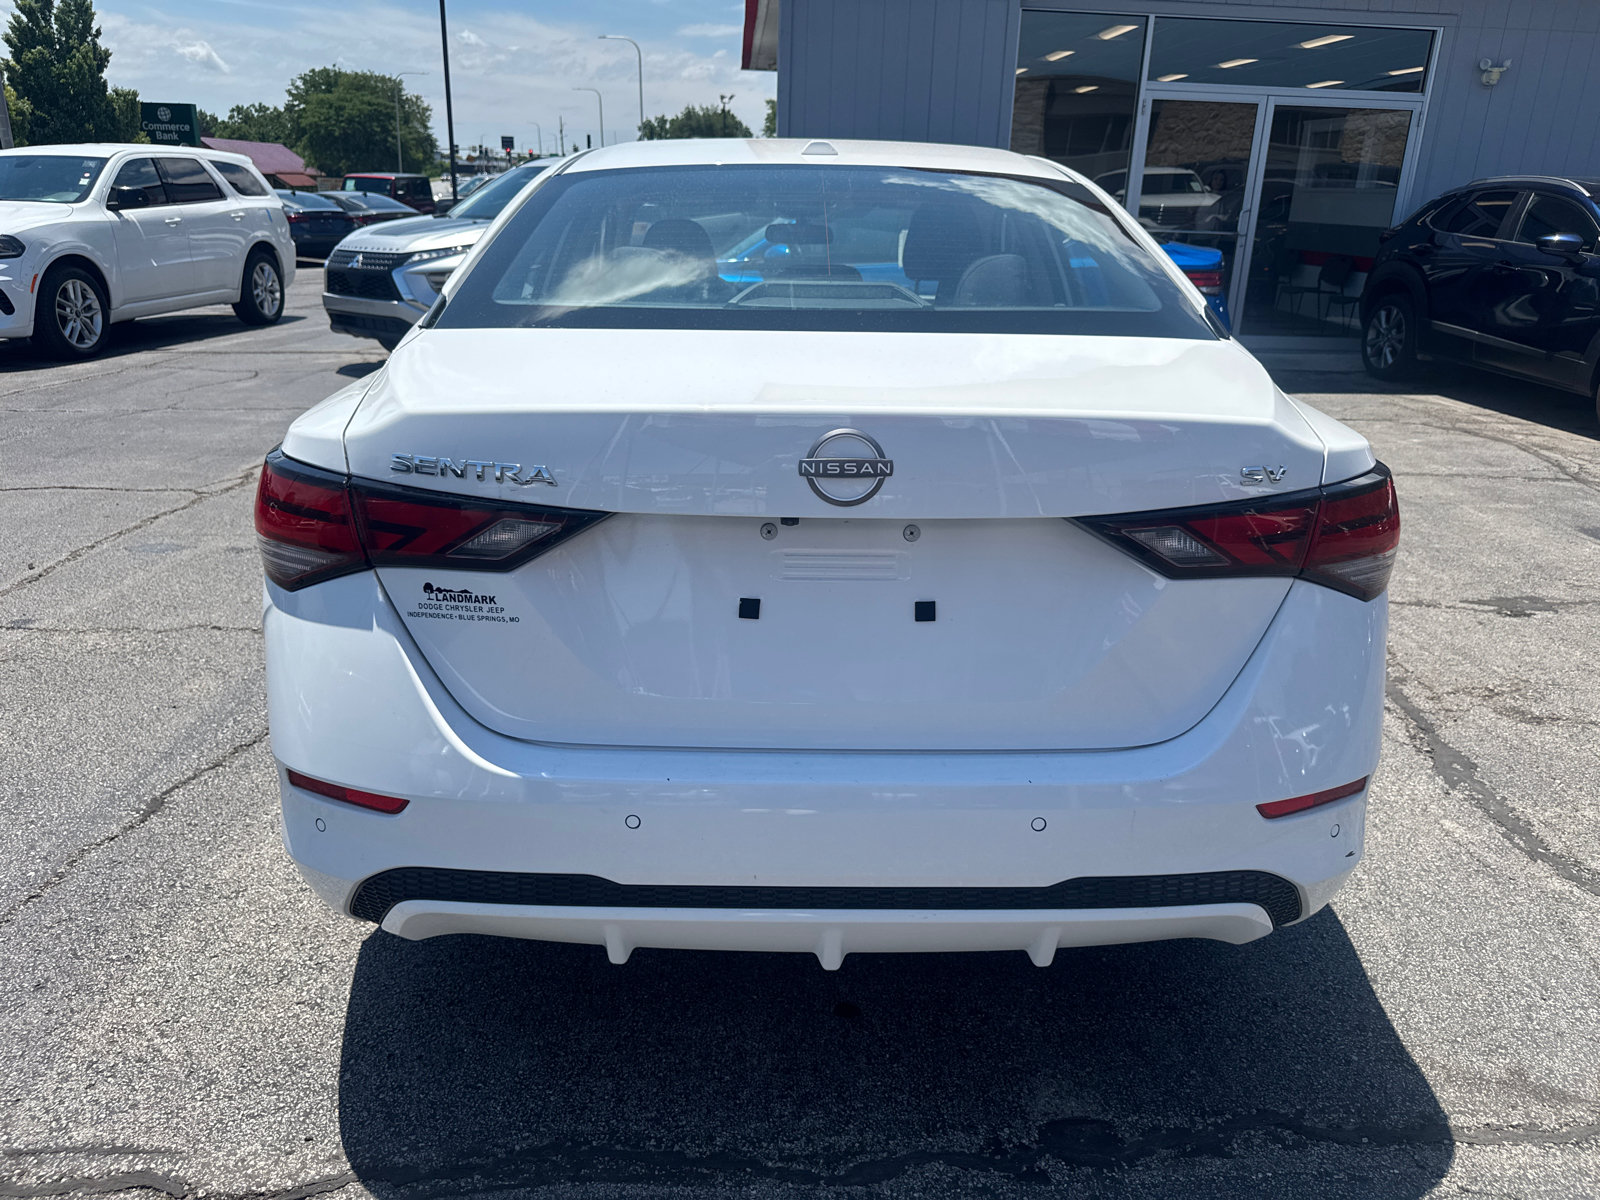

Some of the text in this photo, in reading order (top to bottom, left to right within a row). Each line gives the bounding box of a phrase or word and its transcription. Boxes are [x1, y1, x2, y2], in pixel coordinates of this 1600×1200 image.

[142, 121, 190, 131] Commerce
[156, 131, 179, 140] Bank
[390, 453, 558, 487] SENTRA
[801, 462, 892, 474] NISSAN
[1240, 465, 1287, 486] SV
[435, 592, 497, 605] LANDMARK
[418, 602, 505, 614] DODGE CHRYSLER JEEP
[407, 611, 456, 620] INDEPENDENCE
[458, 613, 476, 621] BLUE
